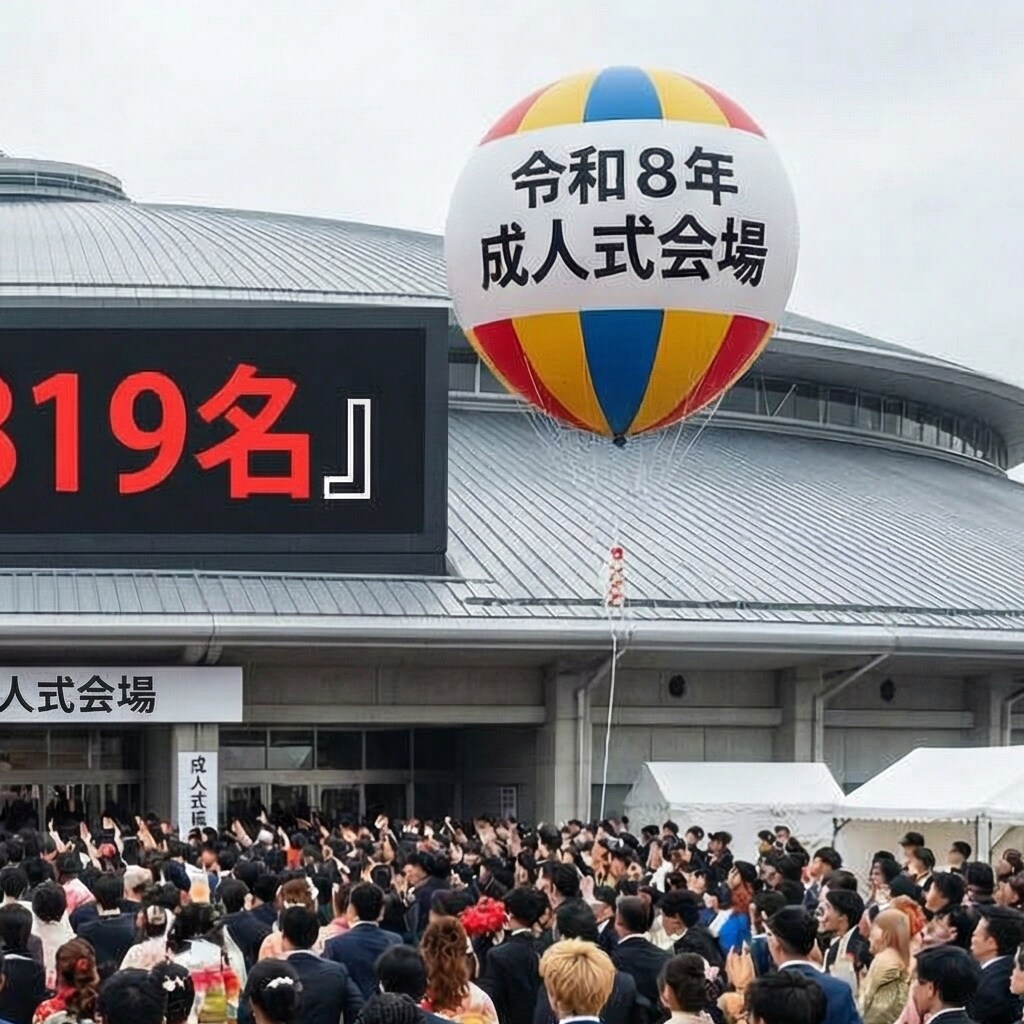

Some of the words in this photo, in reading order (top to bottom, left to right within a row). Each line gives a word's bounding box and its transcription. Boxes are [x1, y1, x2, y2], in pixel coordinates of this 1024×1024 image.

[511, 145, 739, 209] 令和8年
[480, 213, 769, 292] 成人式会場
